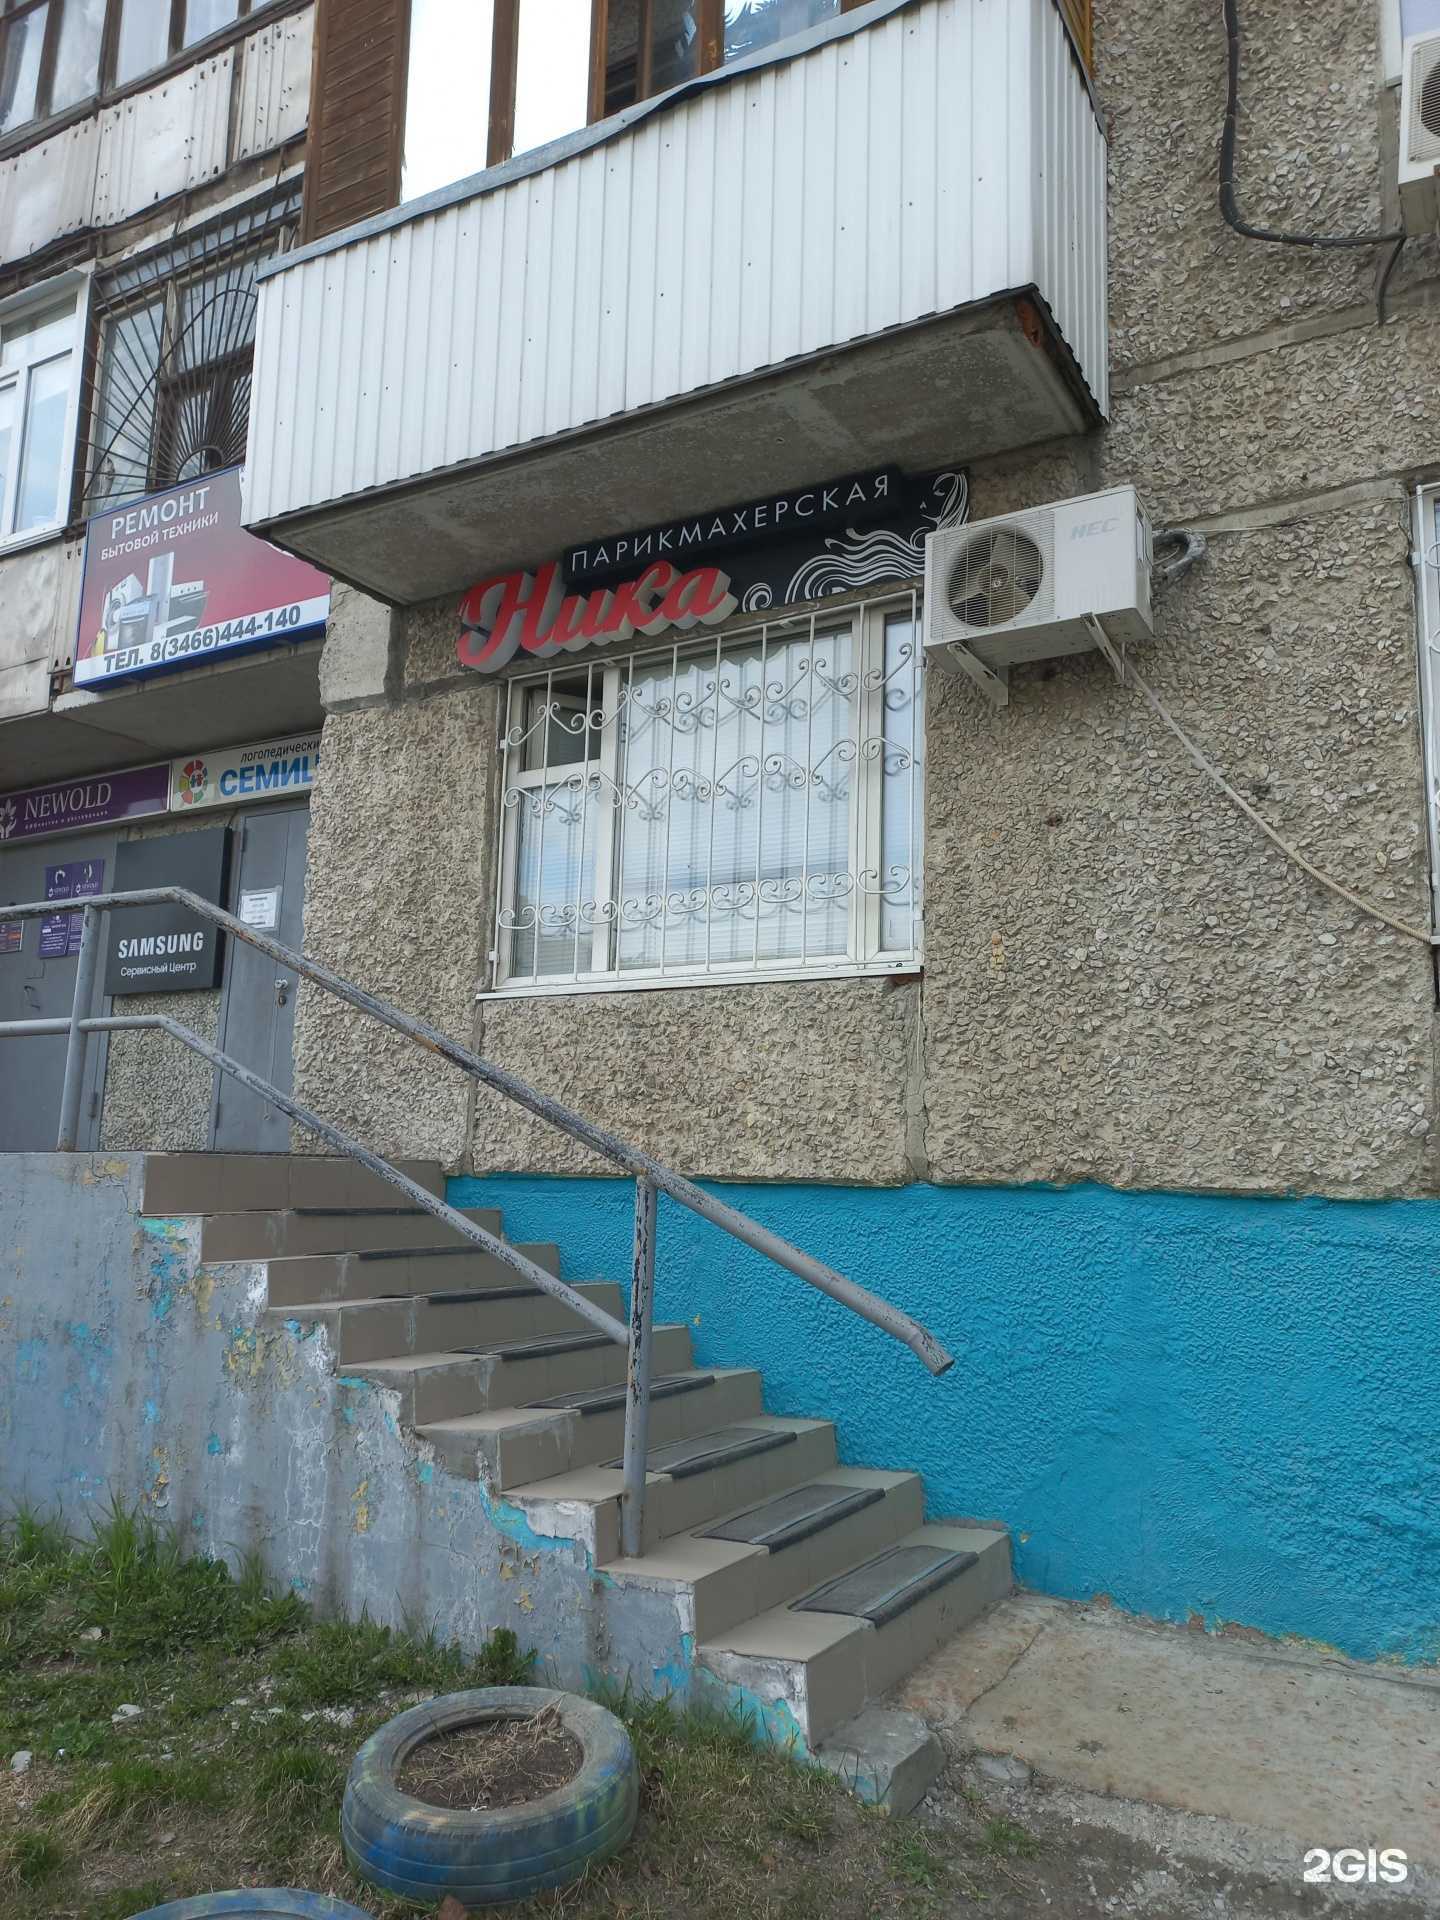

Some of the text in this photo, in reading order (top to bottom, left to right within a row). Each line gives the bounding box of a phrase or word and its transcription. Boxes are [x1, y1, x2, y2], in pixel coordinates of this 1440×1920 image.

[101, 511, 219, 560] БЫТОВОЙ ТЕХНИКИ
[111, 486, 210, 539] РЕМОНТ
[571, 474, 889, 572] ПАРИКМАХЕРСКАЯ
[1071, 518, 1120, 540] NEC
[104, 605, 301, 673] ТЕЛ. 8(3466)444-140
[456, 560, 734, 671] Ника
[24, 782, 112, 821] NEWOLD
[118, 931, 204, 959] SAMSUNG
[120, 961, 197, 979] Сервисный Центр
